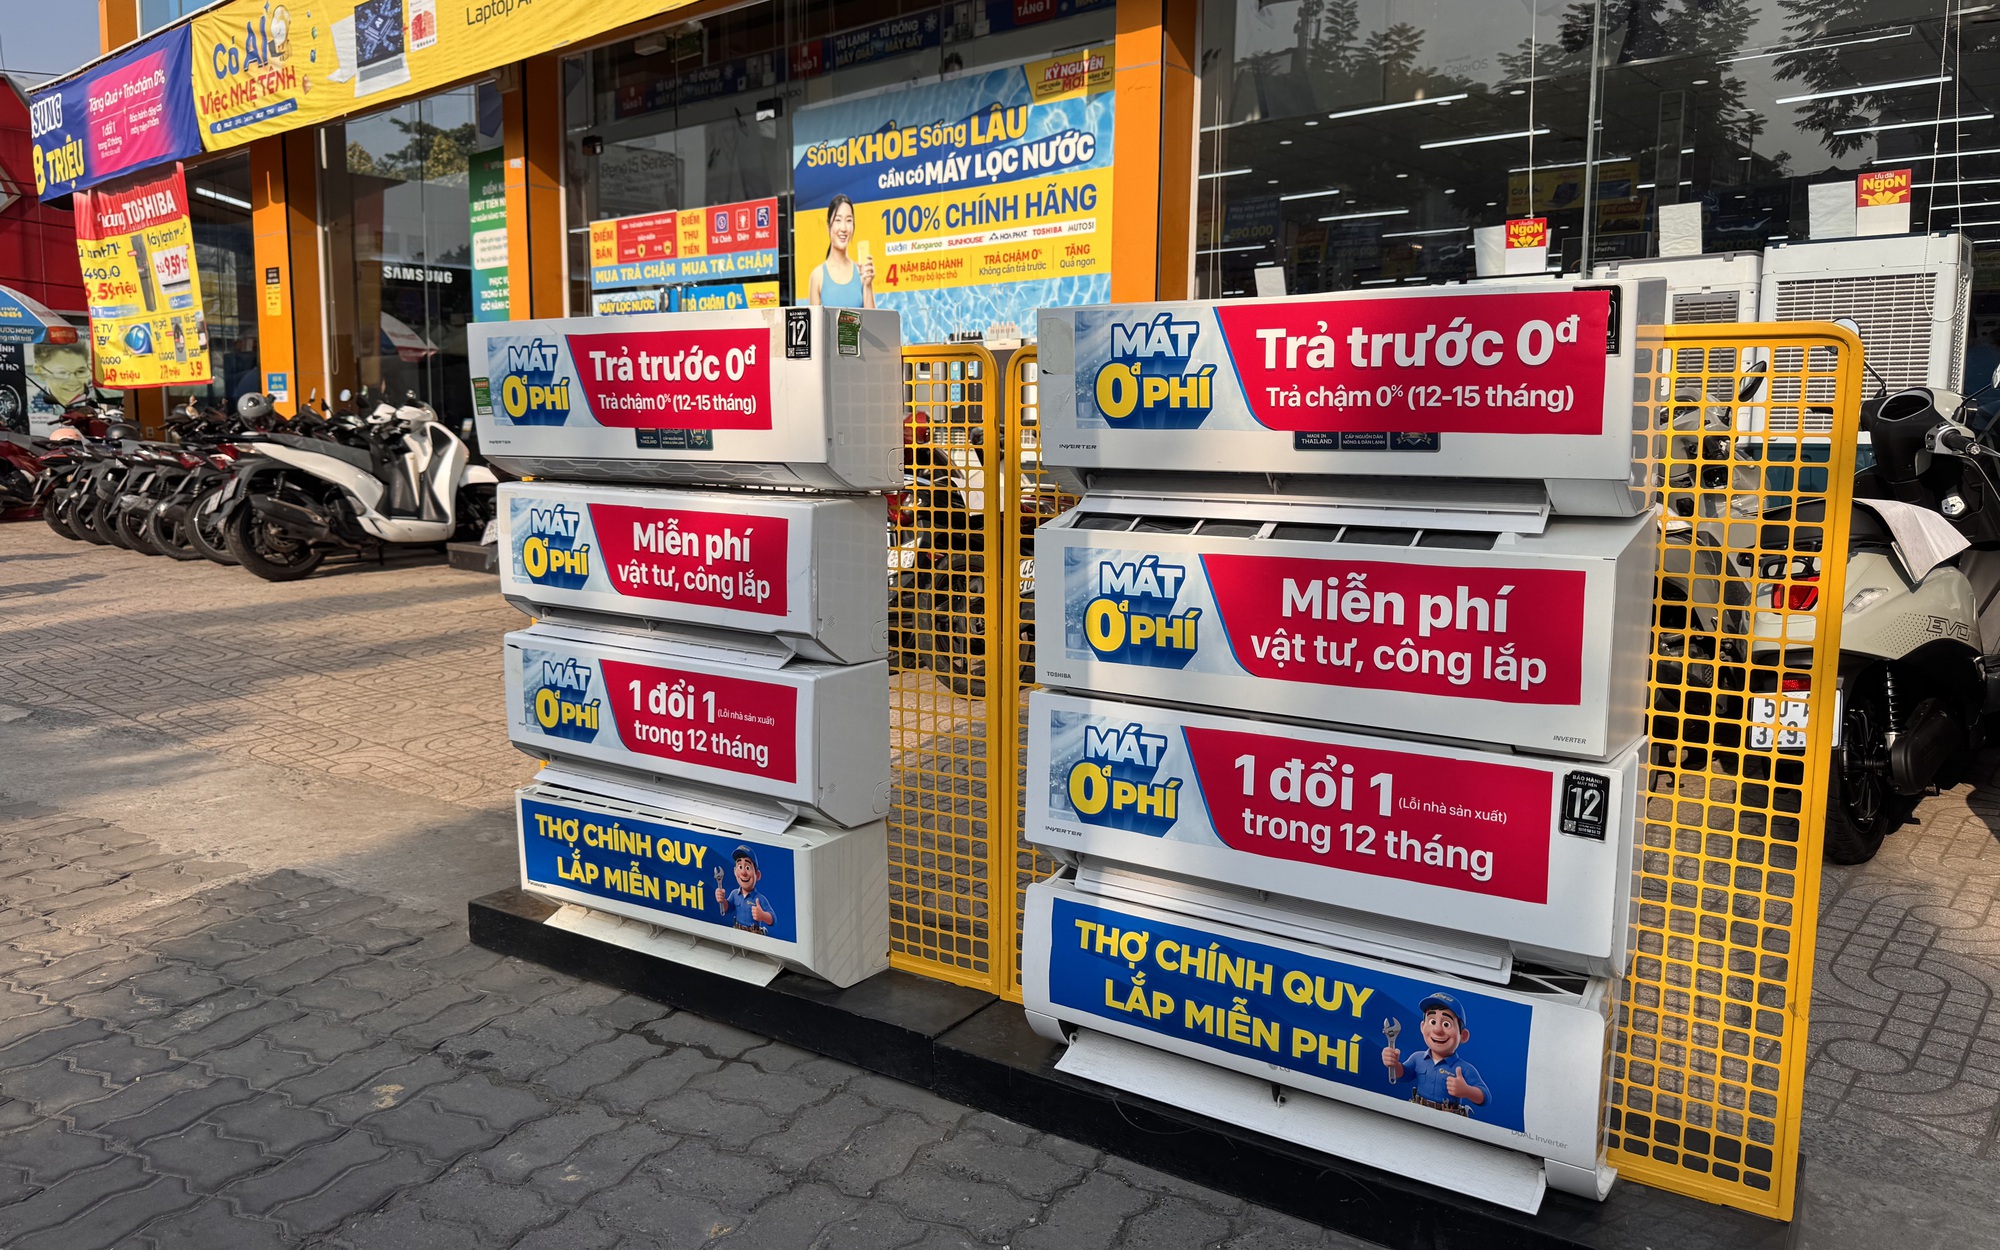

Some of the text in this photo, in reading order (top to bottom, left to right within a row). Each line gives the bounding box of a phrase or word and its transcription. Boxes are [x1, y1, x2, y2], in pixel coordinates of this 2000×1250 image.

[466, 0, 513, 25] Laptop
[243, 15, 268, 72] AI
[807, 103, 1027, 168] Sống KHỎE Sống LÂU
[46, 134, 84, 189] TRIỆU
[878, 130, 1095, 189] CẦN CÓ MÁY LỌC NƯỚC
[1863, 174, 1907, 192] NgoN
[882, 183, 1097, 236] 100% CHÍNH HÃNG
[683, 230, 699, 240] THU
[911, 240, 943, 251] Kangaroo
[947, 236, 983, 247] SUNHOUSE
[1032, 226, 1062, 236] TOSHIBA
[1068, 221, 1094, 232] MUTOSI
[1510, 222, 1543, 236] NgoN
[383, 265, 454, 284] SAMSUNG
[596, 269, 619, 283] MUA
[644, 261, 676, 281] CHẬM
[682, 262, 708, 276] MUA
[737, 251, 774, 273] CHẬM
[886, 263, 899, 287] 4
[1077, 257, 1096, 267] ngon
[101, 324, 113, 334] TV
[789, 320, 807, 346] 12
[1112, 314, 1197, 358] MÁT
[1255, 320, 1336, 369] Trả
[1346, 317, 1504, 368] trước
[1516, 314, 1581, 366] 0đ
[509, 340, 557, 372] MÁT
[589, 344, 757, 381] Trả trước 0đ
[598, 392, 757, 415] Trả chậm 0% (12-15 tháng)
[1265, 383, 1574, 417] Trả chậm 0% (12-15 tháng)
[531, 506, 579, 537] MÁT
[633, 518, 754, 566] Miễn phí
[617, 559, 771, 603] vật tư, công lắp
[1101, 557, 1183, 599] MÁT
[1282, 572, 1515, 637] Miễn phí
[544, 659, 590, 692] MÁT
[1047, 670, 1072, 679] TOSHIBA
[1250, 627, 1547, 691] vật tư, công lắp
[629, 679, 716, 724] 1 đổi 1
[730, 709, 743, 720] nhà
[757, 713, 775, 727] xuất)
[634, 720, 769, 768] trong 12 tháng
[1086, 725, 1166, 767] MÁT
[1553, 735, 1586, 745] INVERTER
[1234, 753, 1392, 817] 1 đổi 1
[1399, 796, 1507, 825] (Lỗi nhà sản xuất)
[1571, 787, 1600, 821] 12
[535, 813, 707, 869] THỢ CHÍNH QUY
[1045, 826, 1082, 837] INVERTER
[1241, 807, 1493, 883] trong 12 tháng
[557, 848, 704, 910] LẮP MIỄN PHÍ
[1075, 918, 1375, 1018] THỢ CHÍNH QUY
[1105, 971, 1363, 1074] LẮP MIỄN PHÍ
